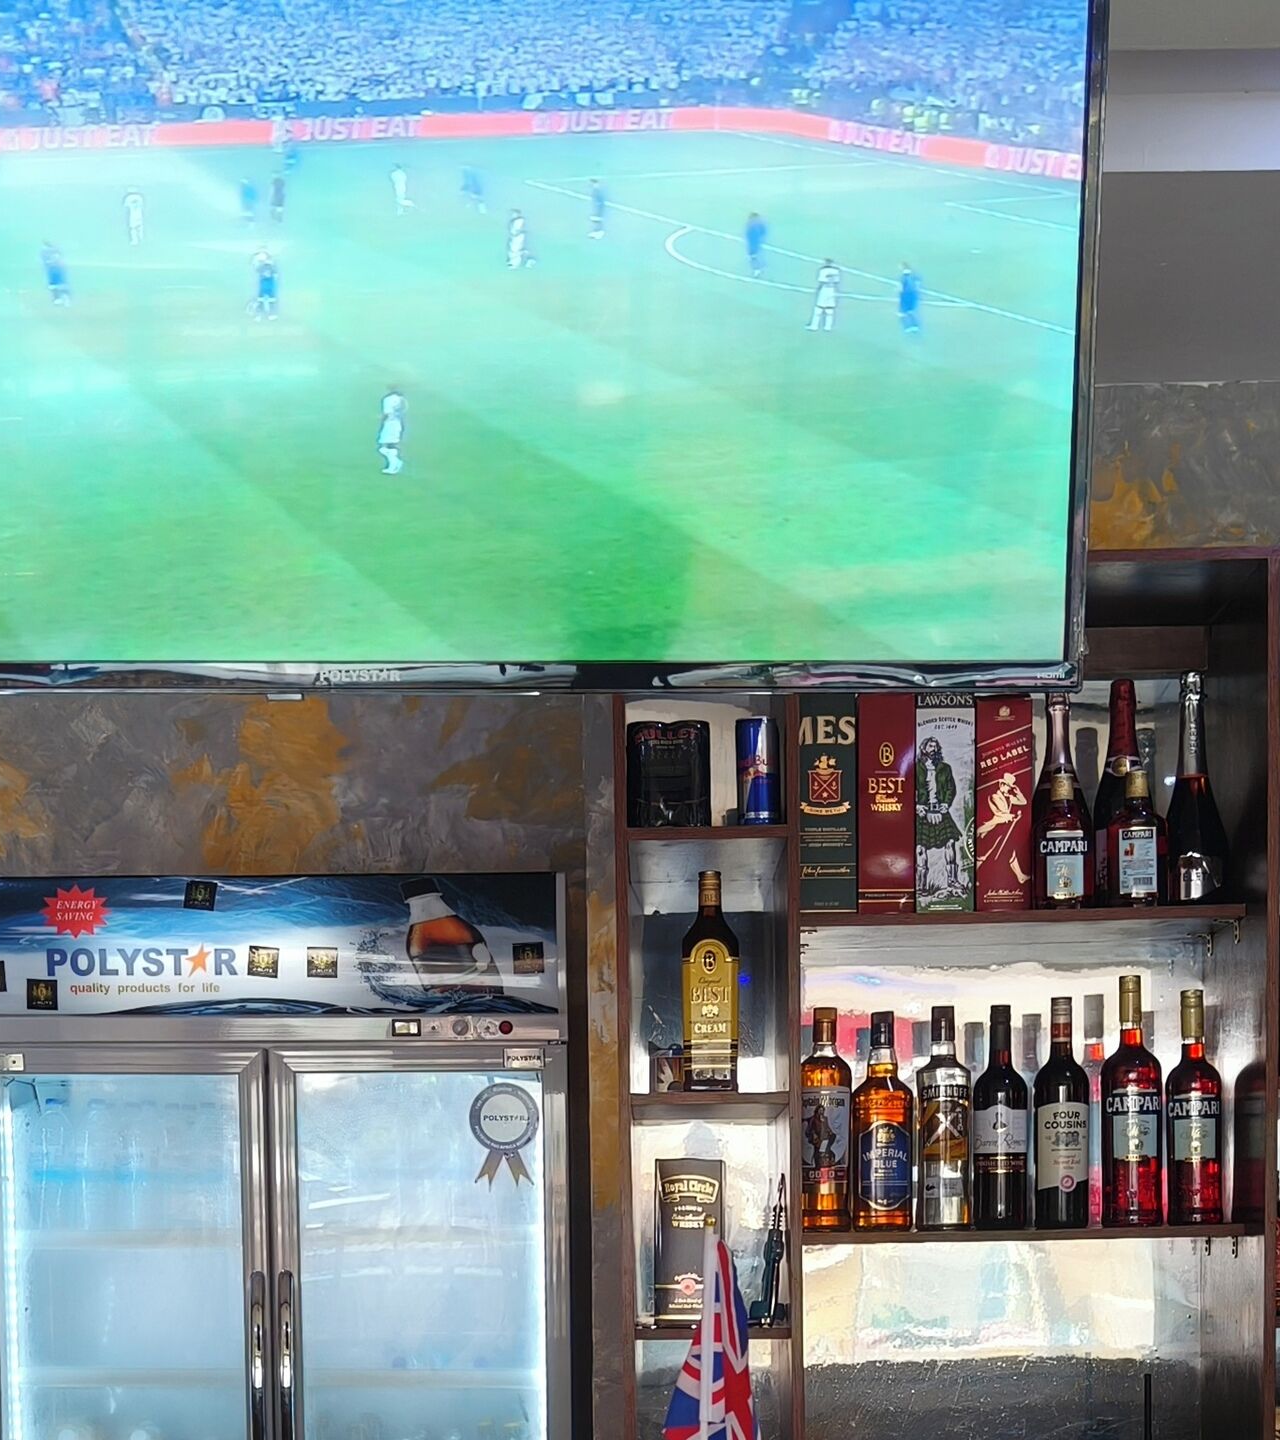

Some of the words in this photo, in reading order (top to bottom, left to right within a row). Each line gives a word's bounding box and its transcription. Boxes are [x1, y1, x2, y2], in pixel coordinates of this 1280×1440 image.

[302, 117, 367, 141] JUST
[373, 115, 421, 138] EAT
[918, 695, 973, 706] LAWSON'S
[980, 756, 999, 769] RED
[1000, 745, 1030, 761] LABEL
[868, 778, 906, 794] BEST
[1123, 831, 1153, 839] CAMPARI
[1040, 840, 1088, 854] CAMPARI
[56, 900, 97, 909] ENERGY
[56, 912, 94, 921] SAVING
[70, 983, 110, 995] quality
[118, 983, 171, 995] products
[178, 982, 195, 993] for
[202, 982, 220, 993] life
[691, 986, 731, 1003] BEST
[695, 1023, 726, 1033] CREAM
[1053, 1111, 1080, 1120] FOUR
[1044, 1120, 1087, 1129] COUSINS
[862, 1148, 908, 1162] IMPERIAL
[873, 1160, 897, 1168] BLUE
[664, 1180, 687, 1193] Royal
[689, 1181, 714, 1194] Circle
